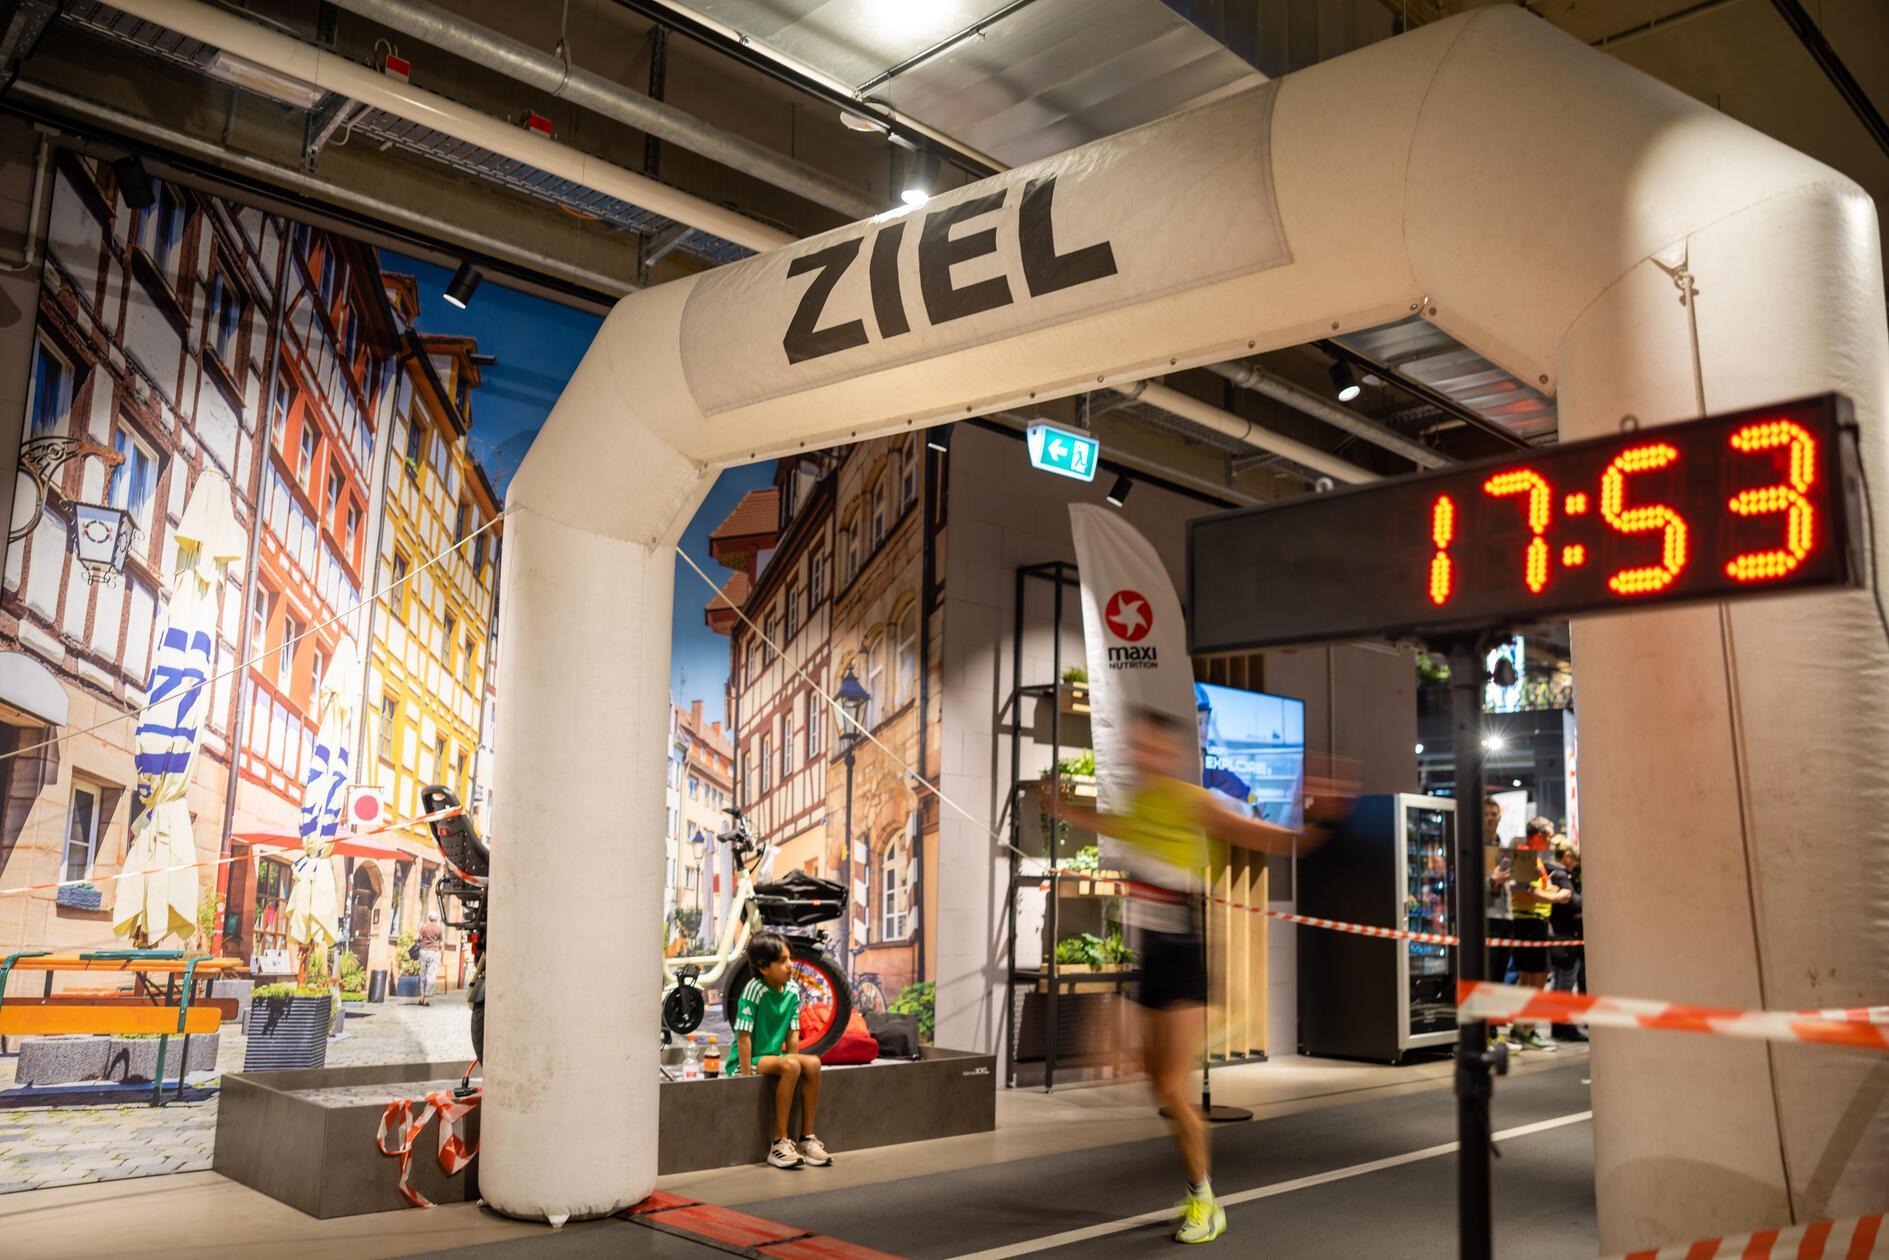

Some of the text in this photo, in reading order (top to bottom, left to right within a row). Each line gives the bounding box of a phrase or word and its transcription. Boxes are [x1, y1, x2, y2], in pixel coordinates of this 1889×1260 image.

[783, 175, 1118, 365] ZIEL
[1429, 420, 1815, 605] 17:53
[1108, 646, 1157, 661] maxi
[1109, 661, 1158, 670] NUTRITION
